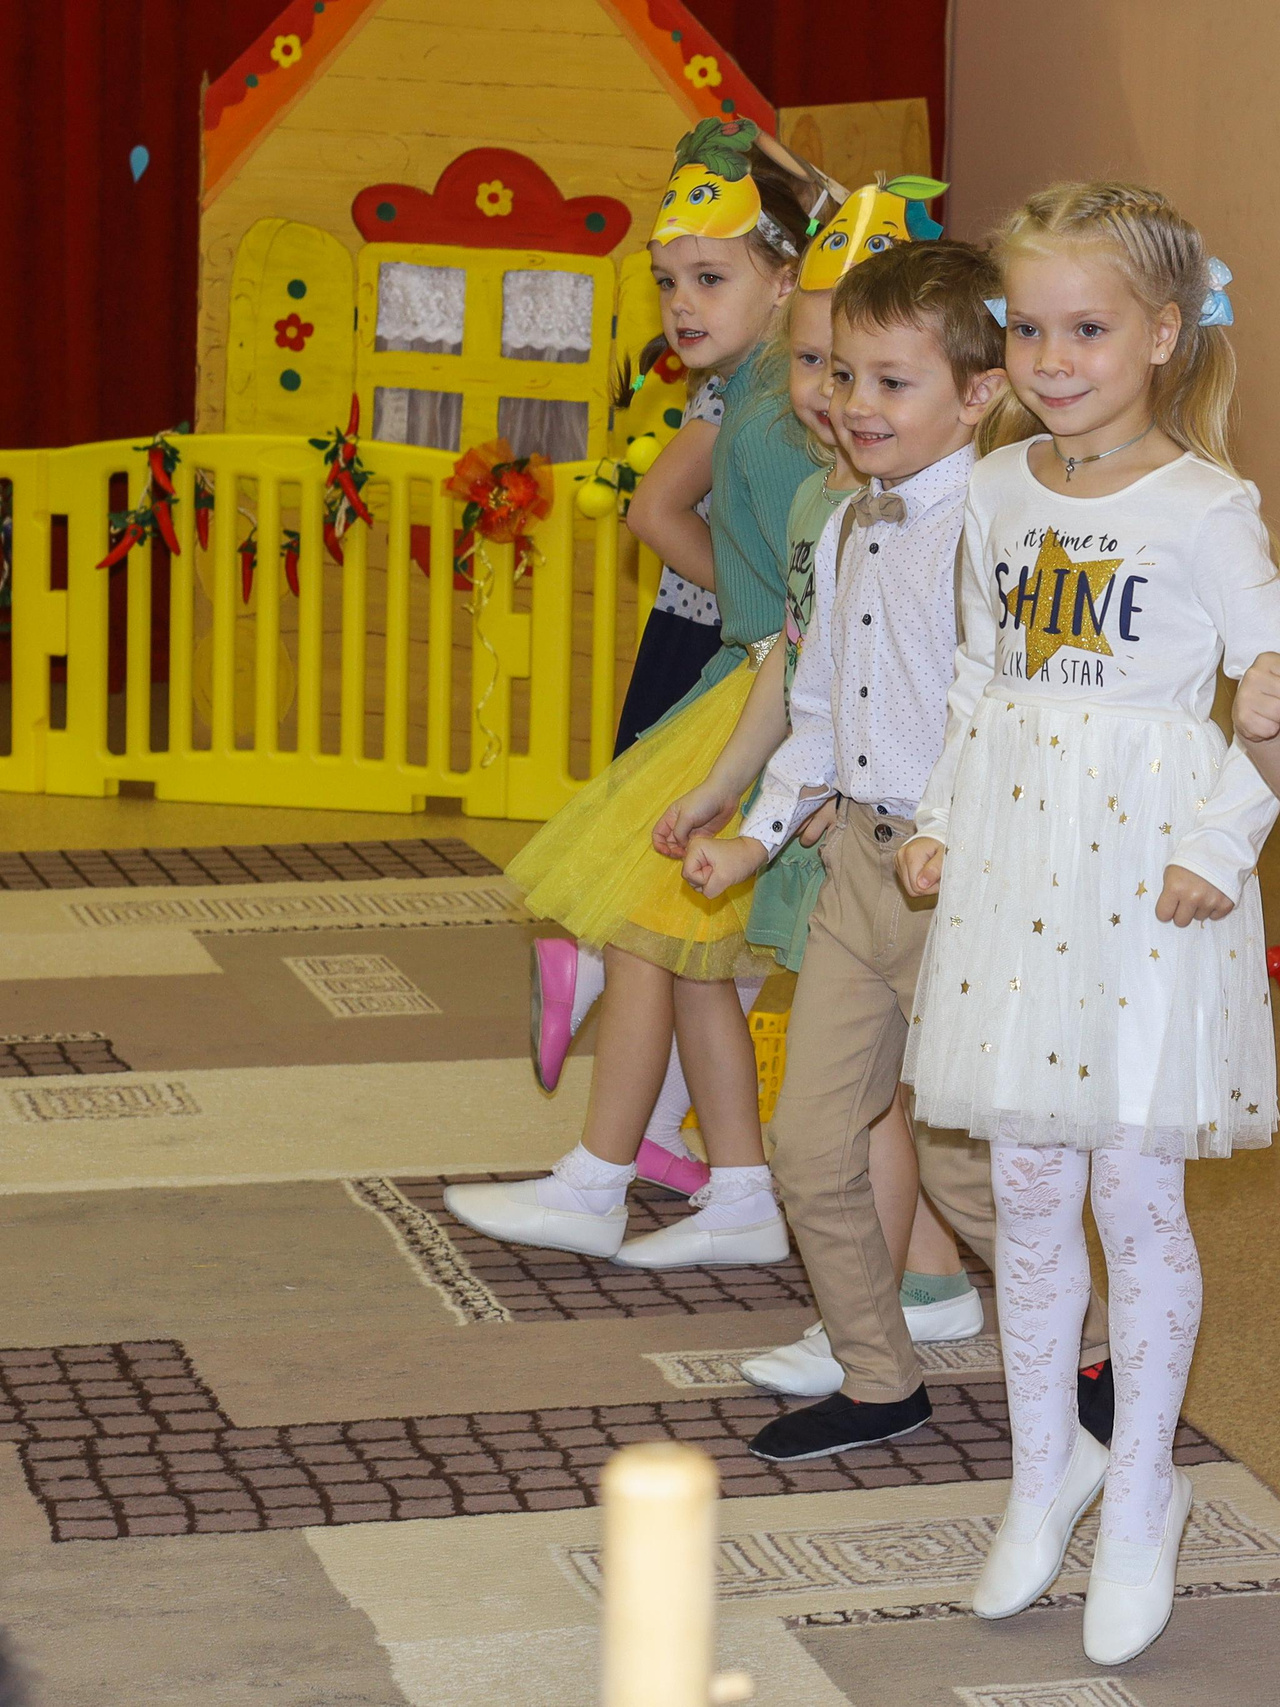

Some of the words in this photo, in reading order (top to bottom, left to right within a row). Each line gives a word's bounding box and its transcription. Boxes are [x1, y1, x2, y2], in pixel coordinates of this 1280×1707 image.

[1023, 528, 1046, 548] it's
[1052, 529, 1094, 552] time
[1099, 533, 1118, 553] to
[995, 562, 1149, 642] SHINE
[1002, 651, 1031, 680] LIKE
[1040, 656, 1050, 682] A
[1060, 658, 1104, 688] STAR
